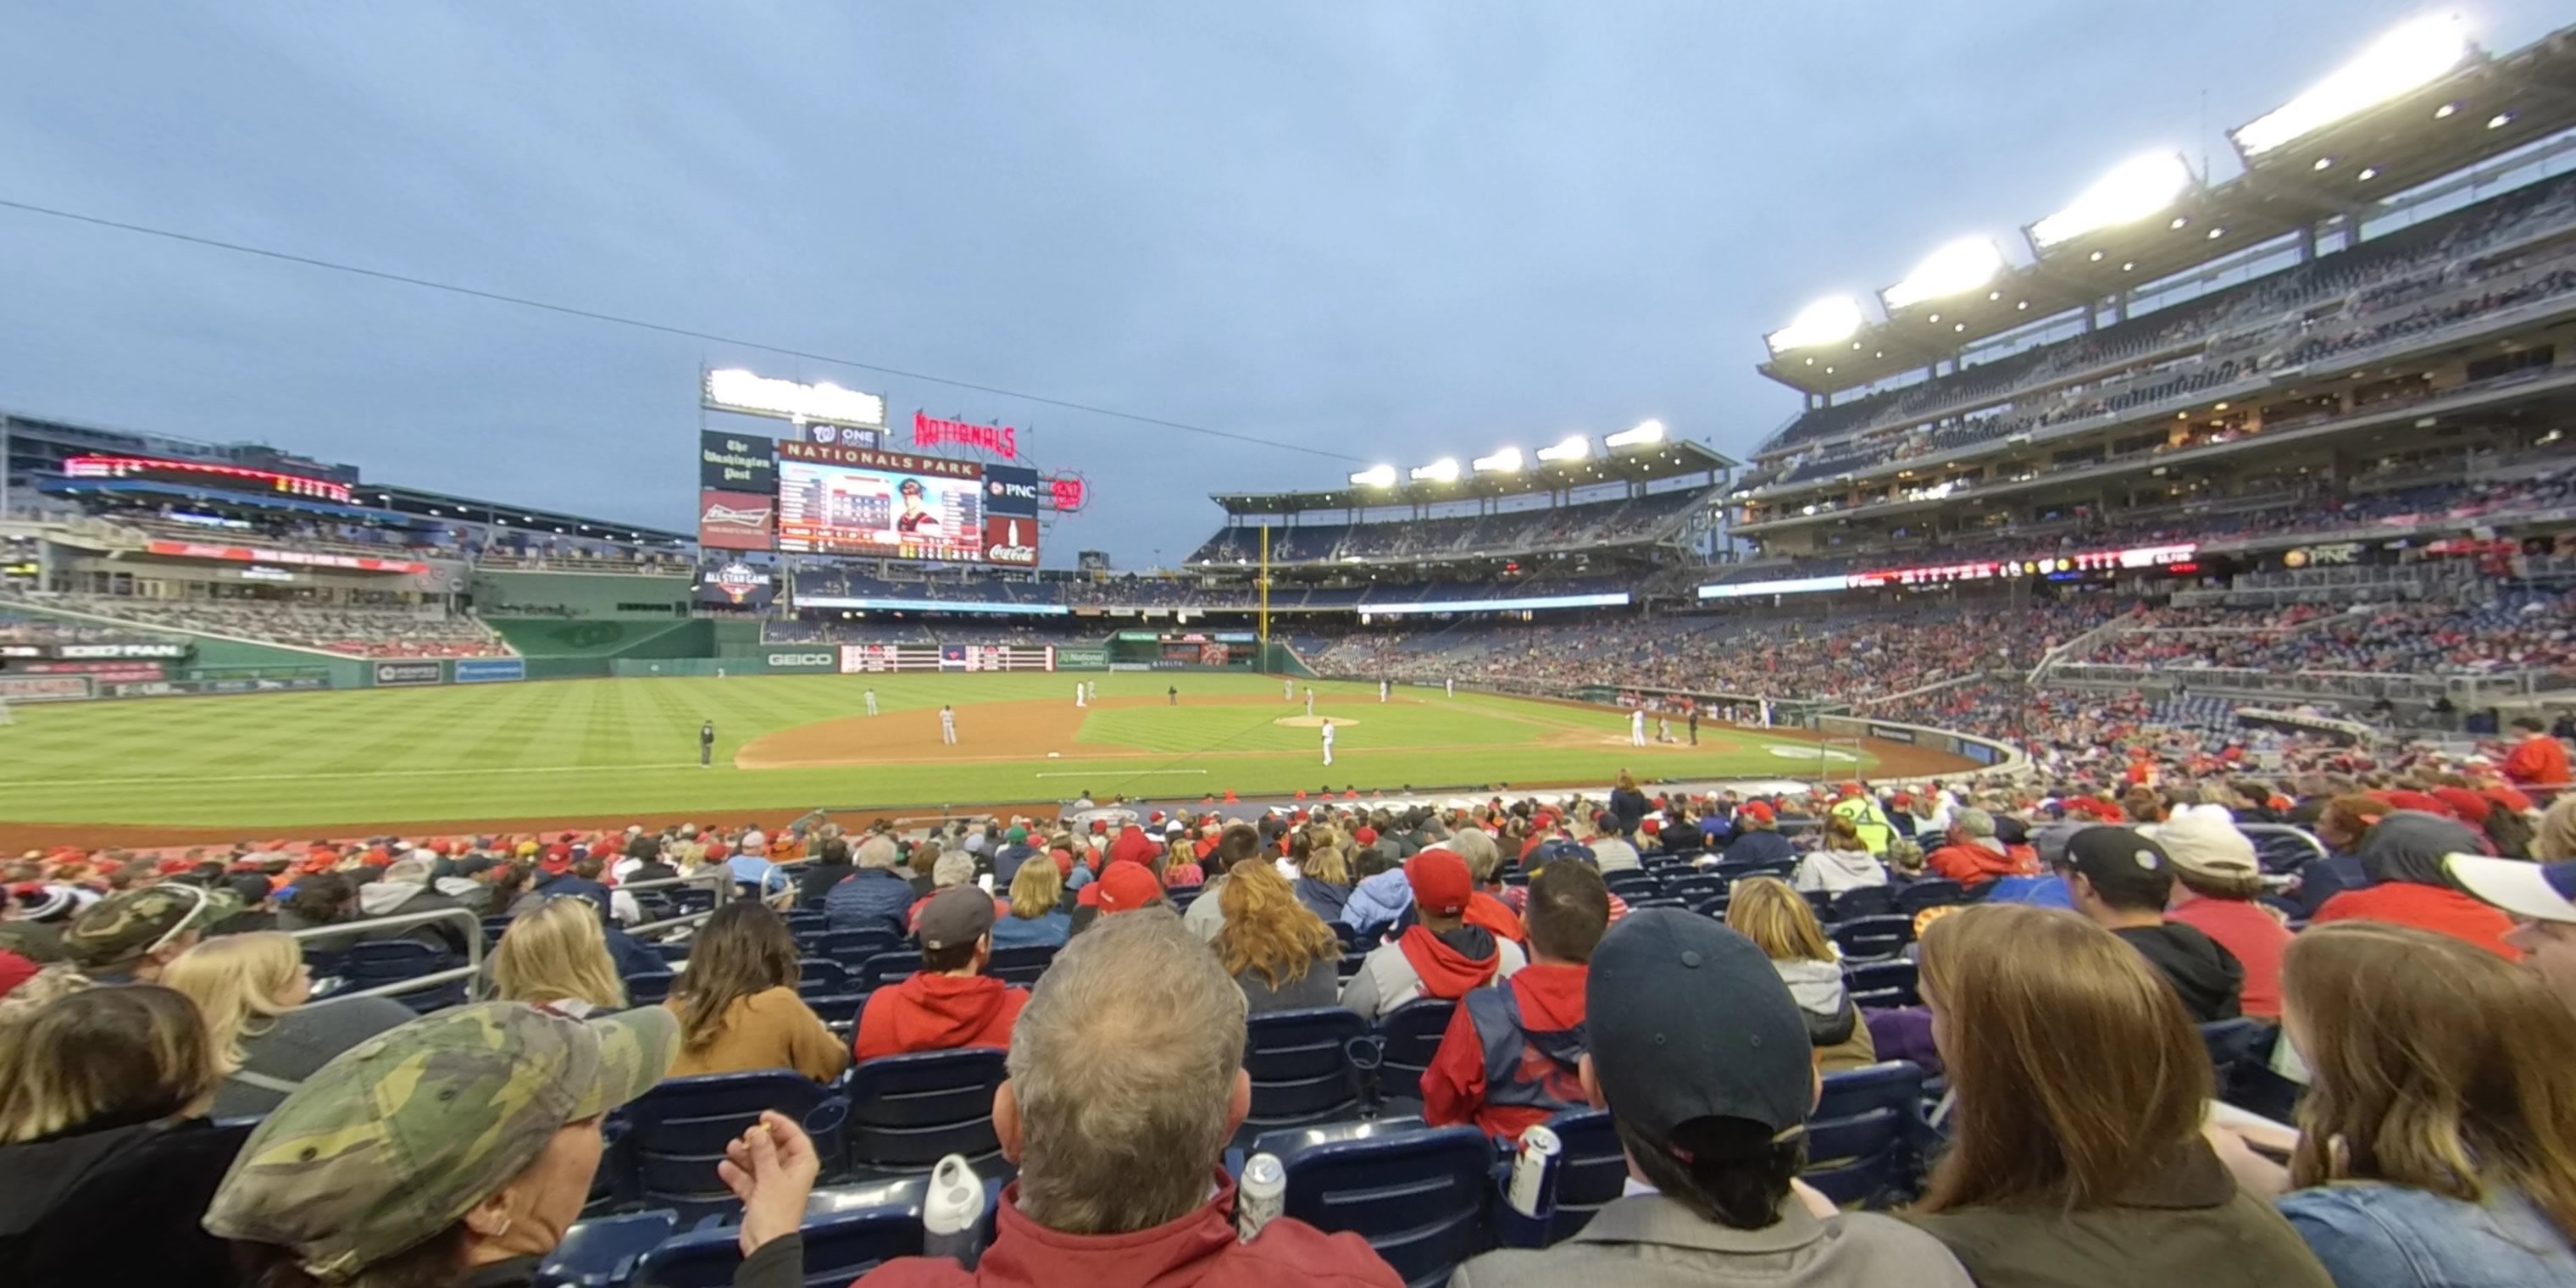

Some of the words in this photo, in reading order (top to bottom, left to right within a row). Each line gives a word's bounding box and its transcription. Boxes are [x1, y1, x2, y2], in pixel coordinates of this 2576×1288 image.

[841, 429, 874, 443] ONE
[913, 413, 1016, 459] NATIONALS
[726, 440, 749, 452] The
[704, 450, 770, 468] Washington
[787, 444, 913, 469] NATIONALS
[922, 459, 973, 475] PARK
[724, 468, 752, 481] Post
[1006, 484, 1036, 498] PNC
[705, 572, 719, 583] ALL
[721, 574, 745, 584] STAR
[768, 653, 832, 666] GEICO
[1069, 652, 1105, 662] National
